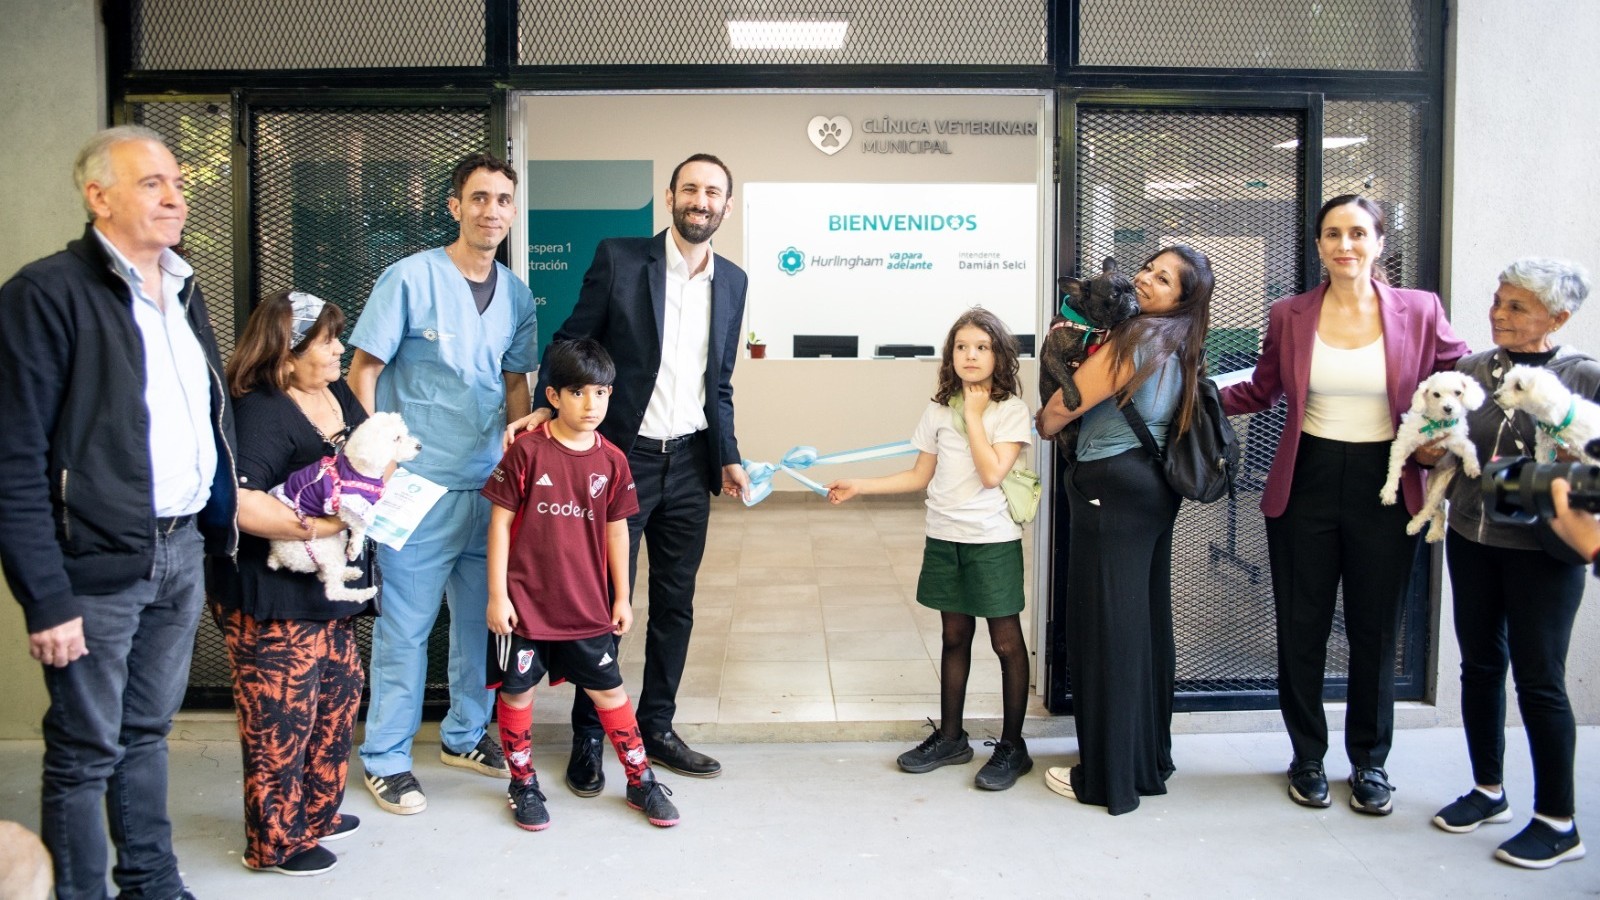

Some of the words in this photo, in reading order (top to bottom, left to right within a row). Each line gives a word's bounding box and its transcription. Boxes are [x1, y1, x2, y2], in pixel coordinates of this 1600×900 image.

[862, 116, 930, 134] CLÍNICA
[935, 120, 1038, 136] VETERINAR
[862, 139, 953, 154] MUNICIPAL
[829, 214, 977, 231] BIENVENIDOS
[528, 244, 563, 255] espera
[566, 242, 571, 253] 1
[810, 255, 884, 270] Hurlingham
[889, 252, 901, 260] va
[901, 252, 923, 262] para
[886, 260, 933, 270] adelante
[959, 259, 1000, 270] Damián
[1002, 259, 1026, 270] Selci
[534, 296, 547, 305] os
[537, 501, 594, 521] codere
